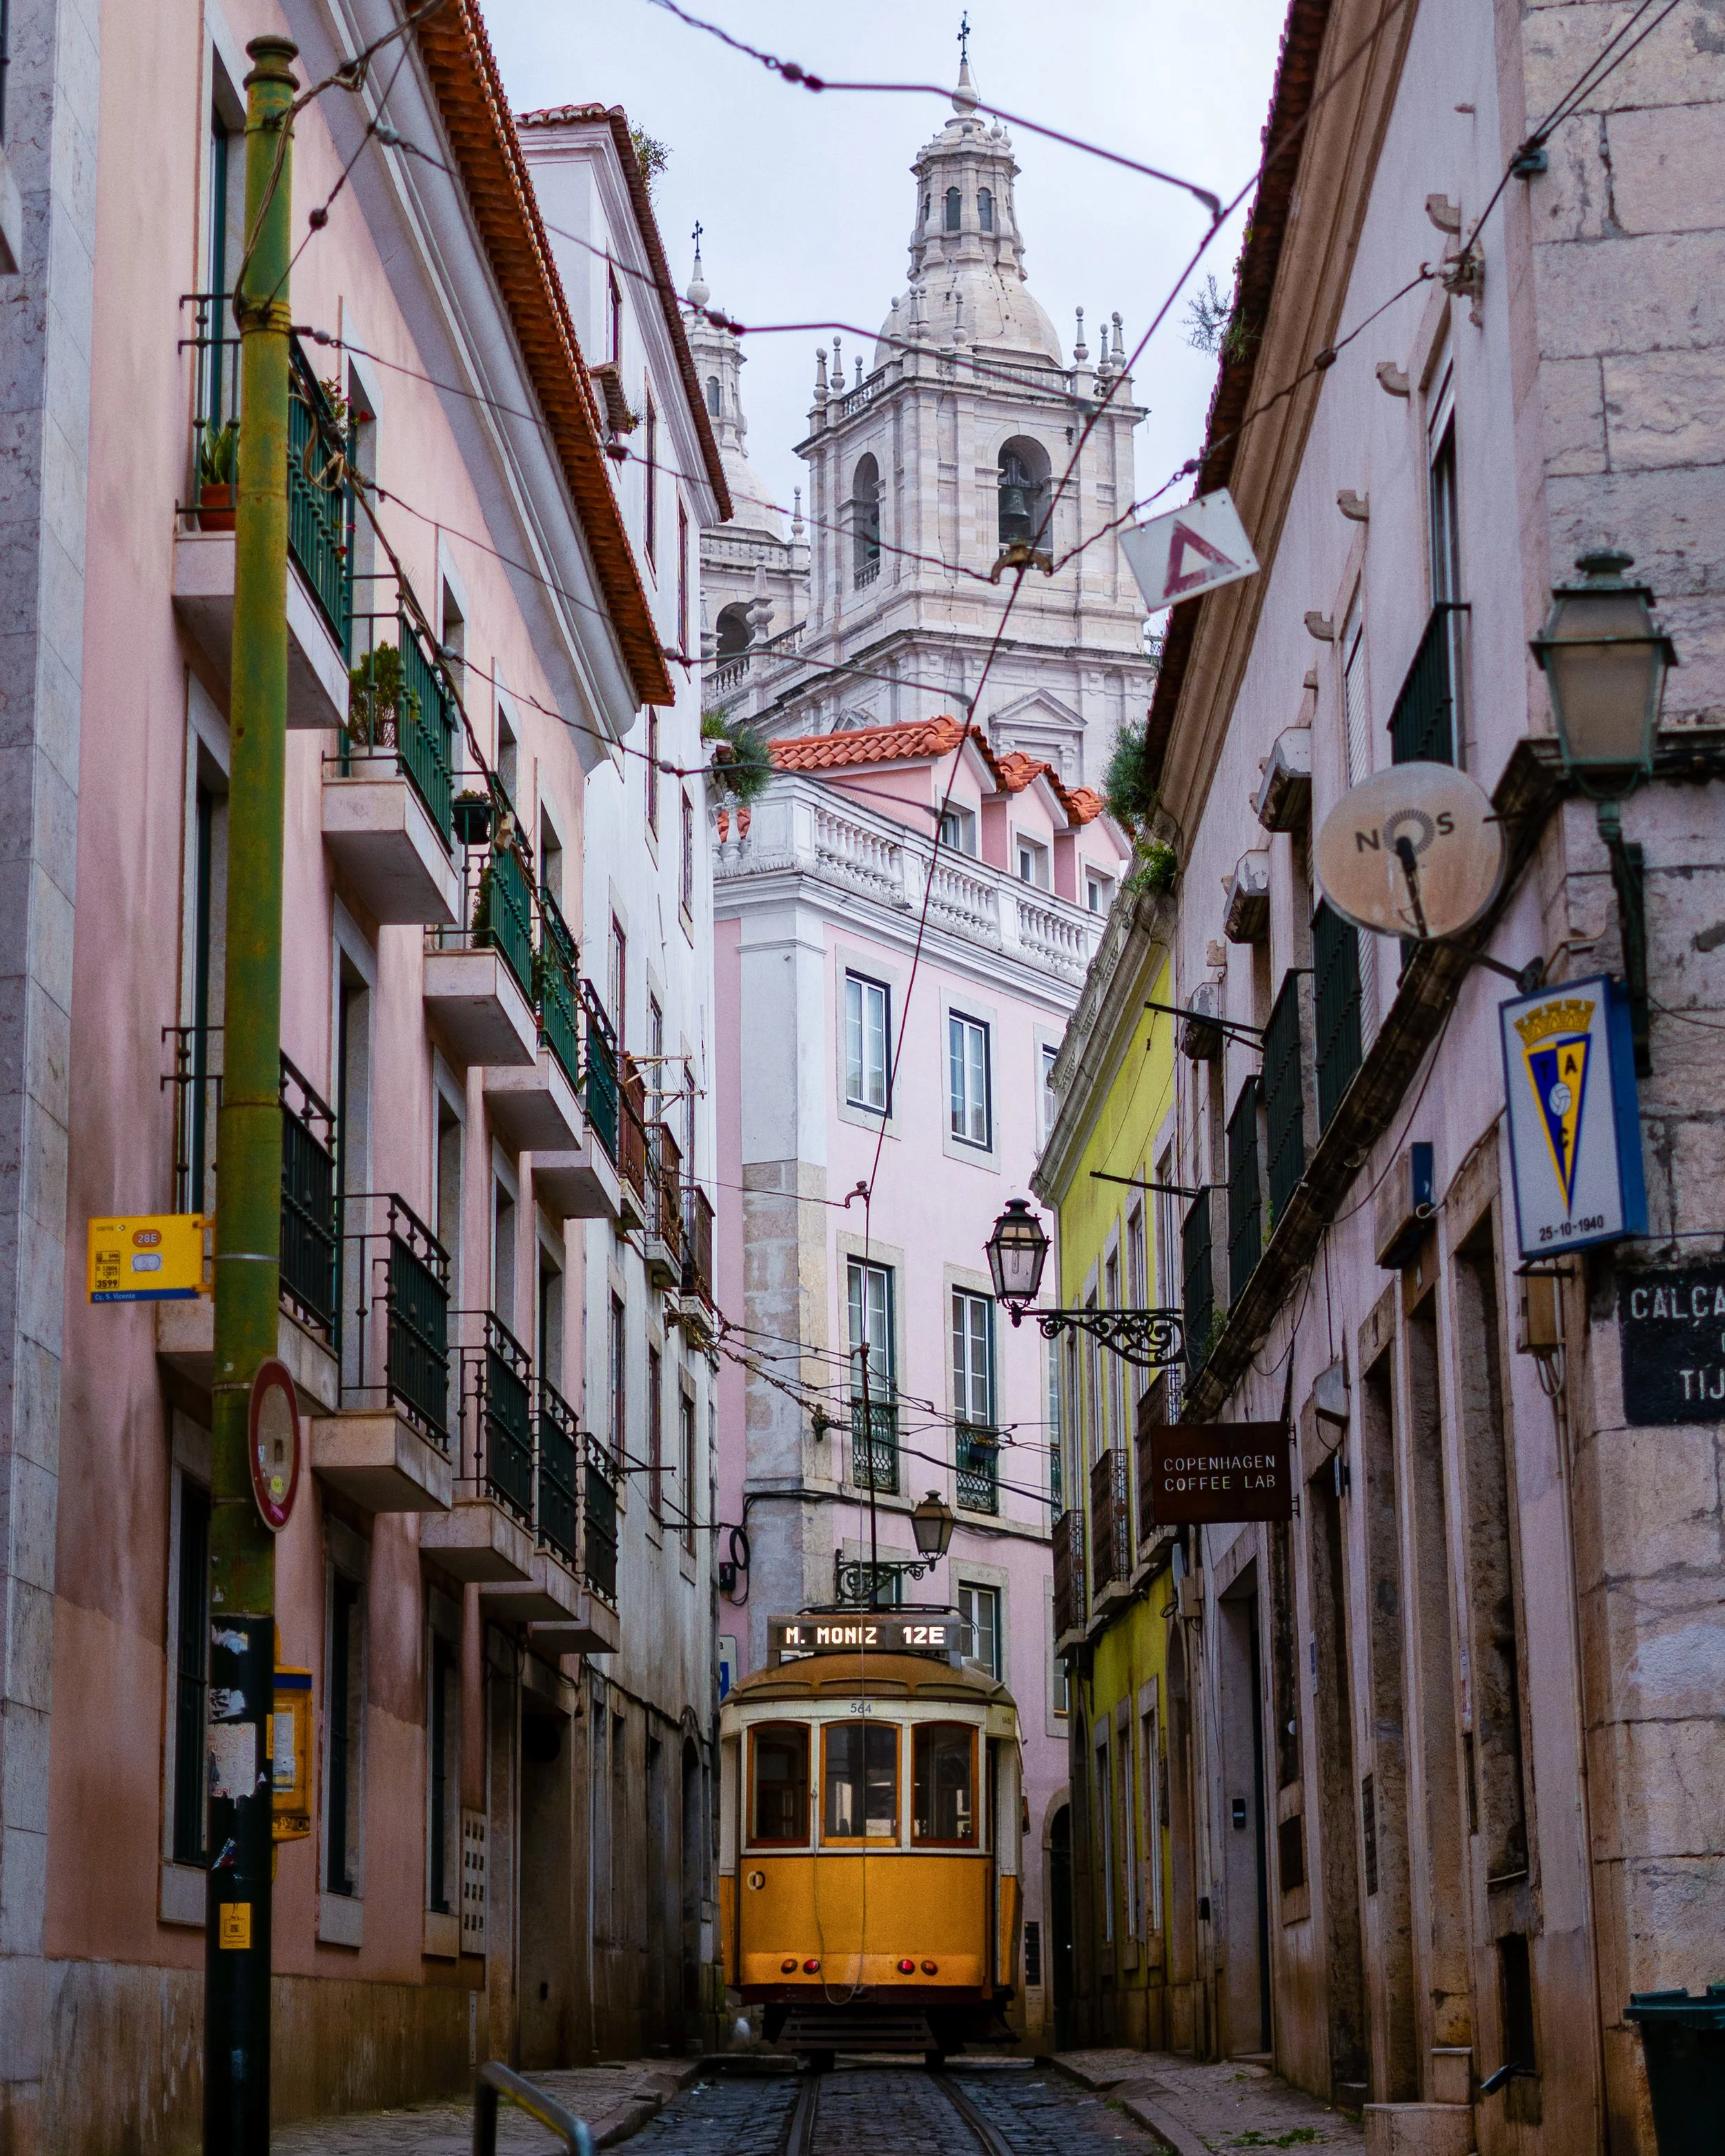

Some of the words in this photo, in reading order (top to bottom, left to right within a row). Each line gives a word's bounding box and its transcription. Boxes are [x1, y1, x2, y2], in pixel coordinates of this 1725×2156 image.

[1564, 1054, 1578, 1076] A
[1557, 1127, 1570, 1149] C
[1539, 1214, 1604, 1242] 25-10-1940
[137, 1233, 158, 1243] 28E
[97, 1279, 118, 1288] 3599
[1164, 1455, 1275, 1472] COPENHAGEN
[1165, 1476, 1231, 1492] COFFEE
[1245, 1474, 1275, 1489] LAB
[786, 1627, 806, 1644] M.
[817, 1627, 877, 1644] MONIZ
[903, 1626, 945, 1644] 12E
[850, 1703, 872, 1714] 564
